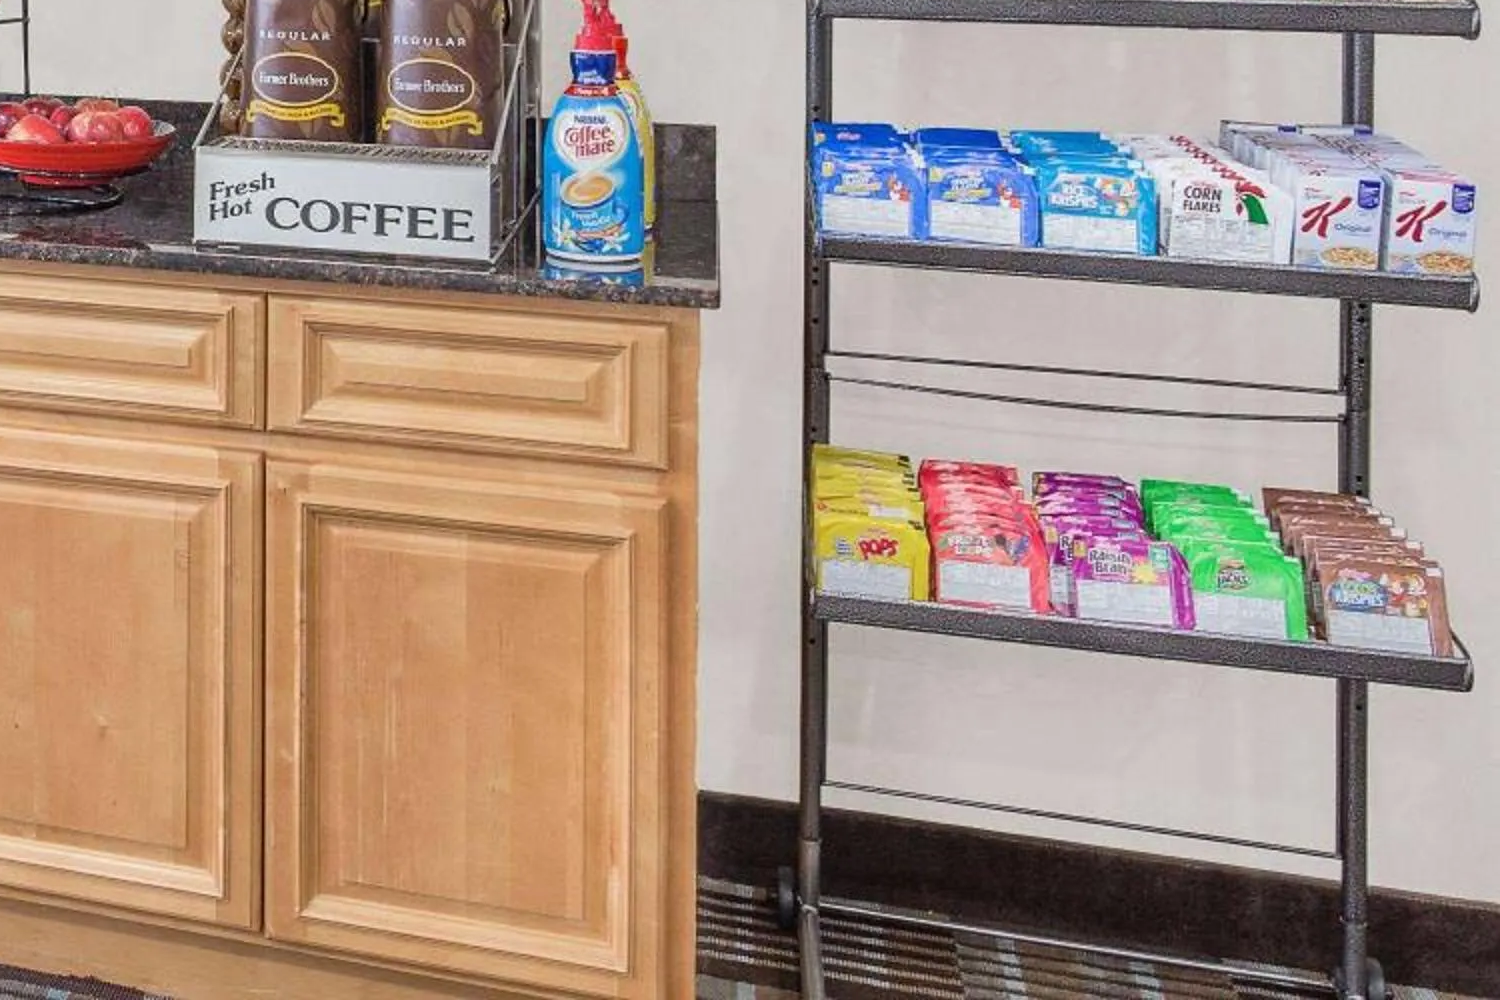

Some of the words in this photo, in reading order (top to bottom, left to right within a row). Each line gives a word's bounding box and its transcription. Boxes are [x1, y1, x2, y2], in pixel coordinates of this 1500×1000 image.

[393, 36, 467, 47] REGULAR
[209, 171, 276, 201] Fresh
[1183, 185, 1223, 201] CORN
[209, 199, 253, 222] Hot
[1182, 199, 1222, 214] FLAKES
[1301, 195, 1353, 239] K
[265, 197, 475, 243] COFFEE
[1395, 199, 1448, 243] K
